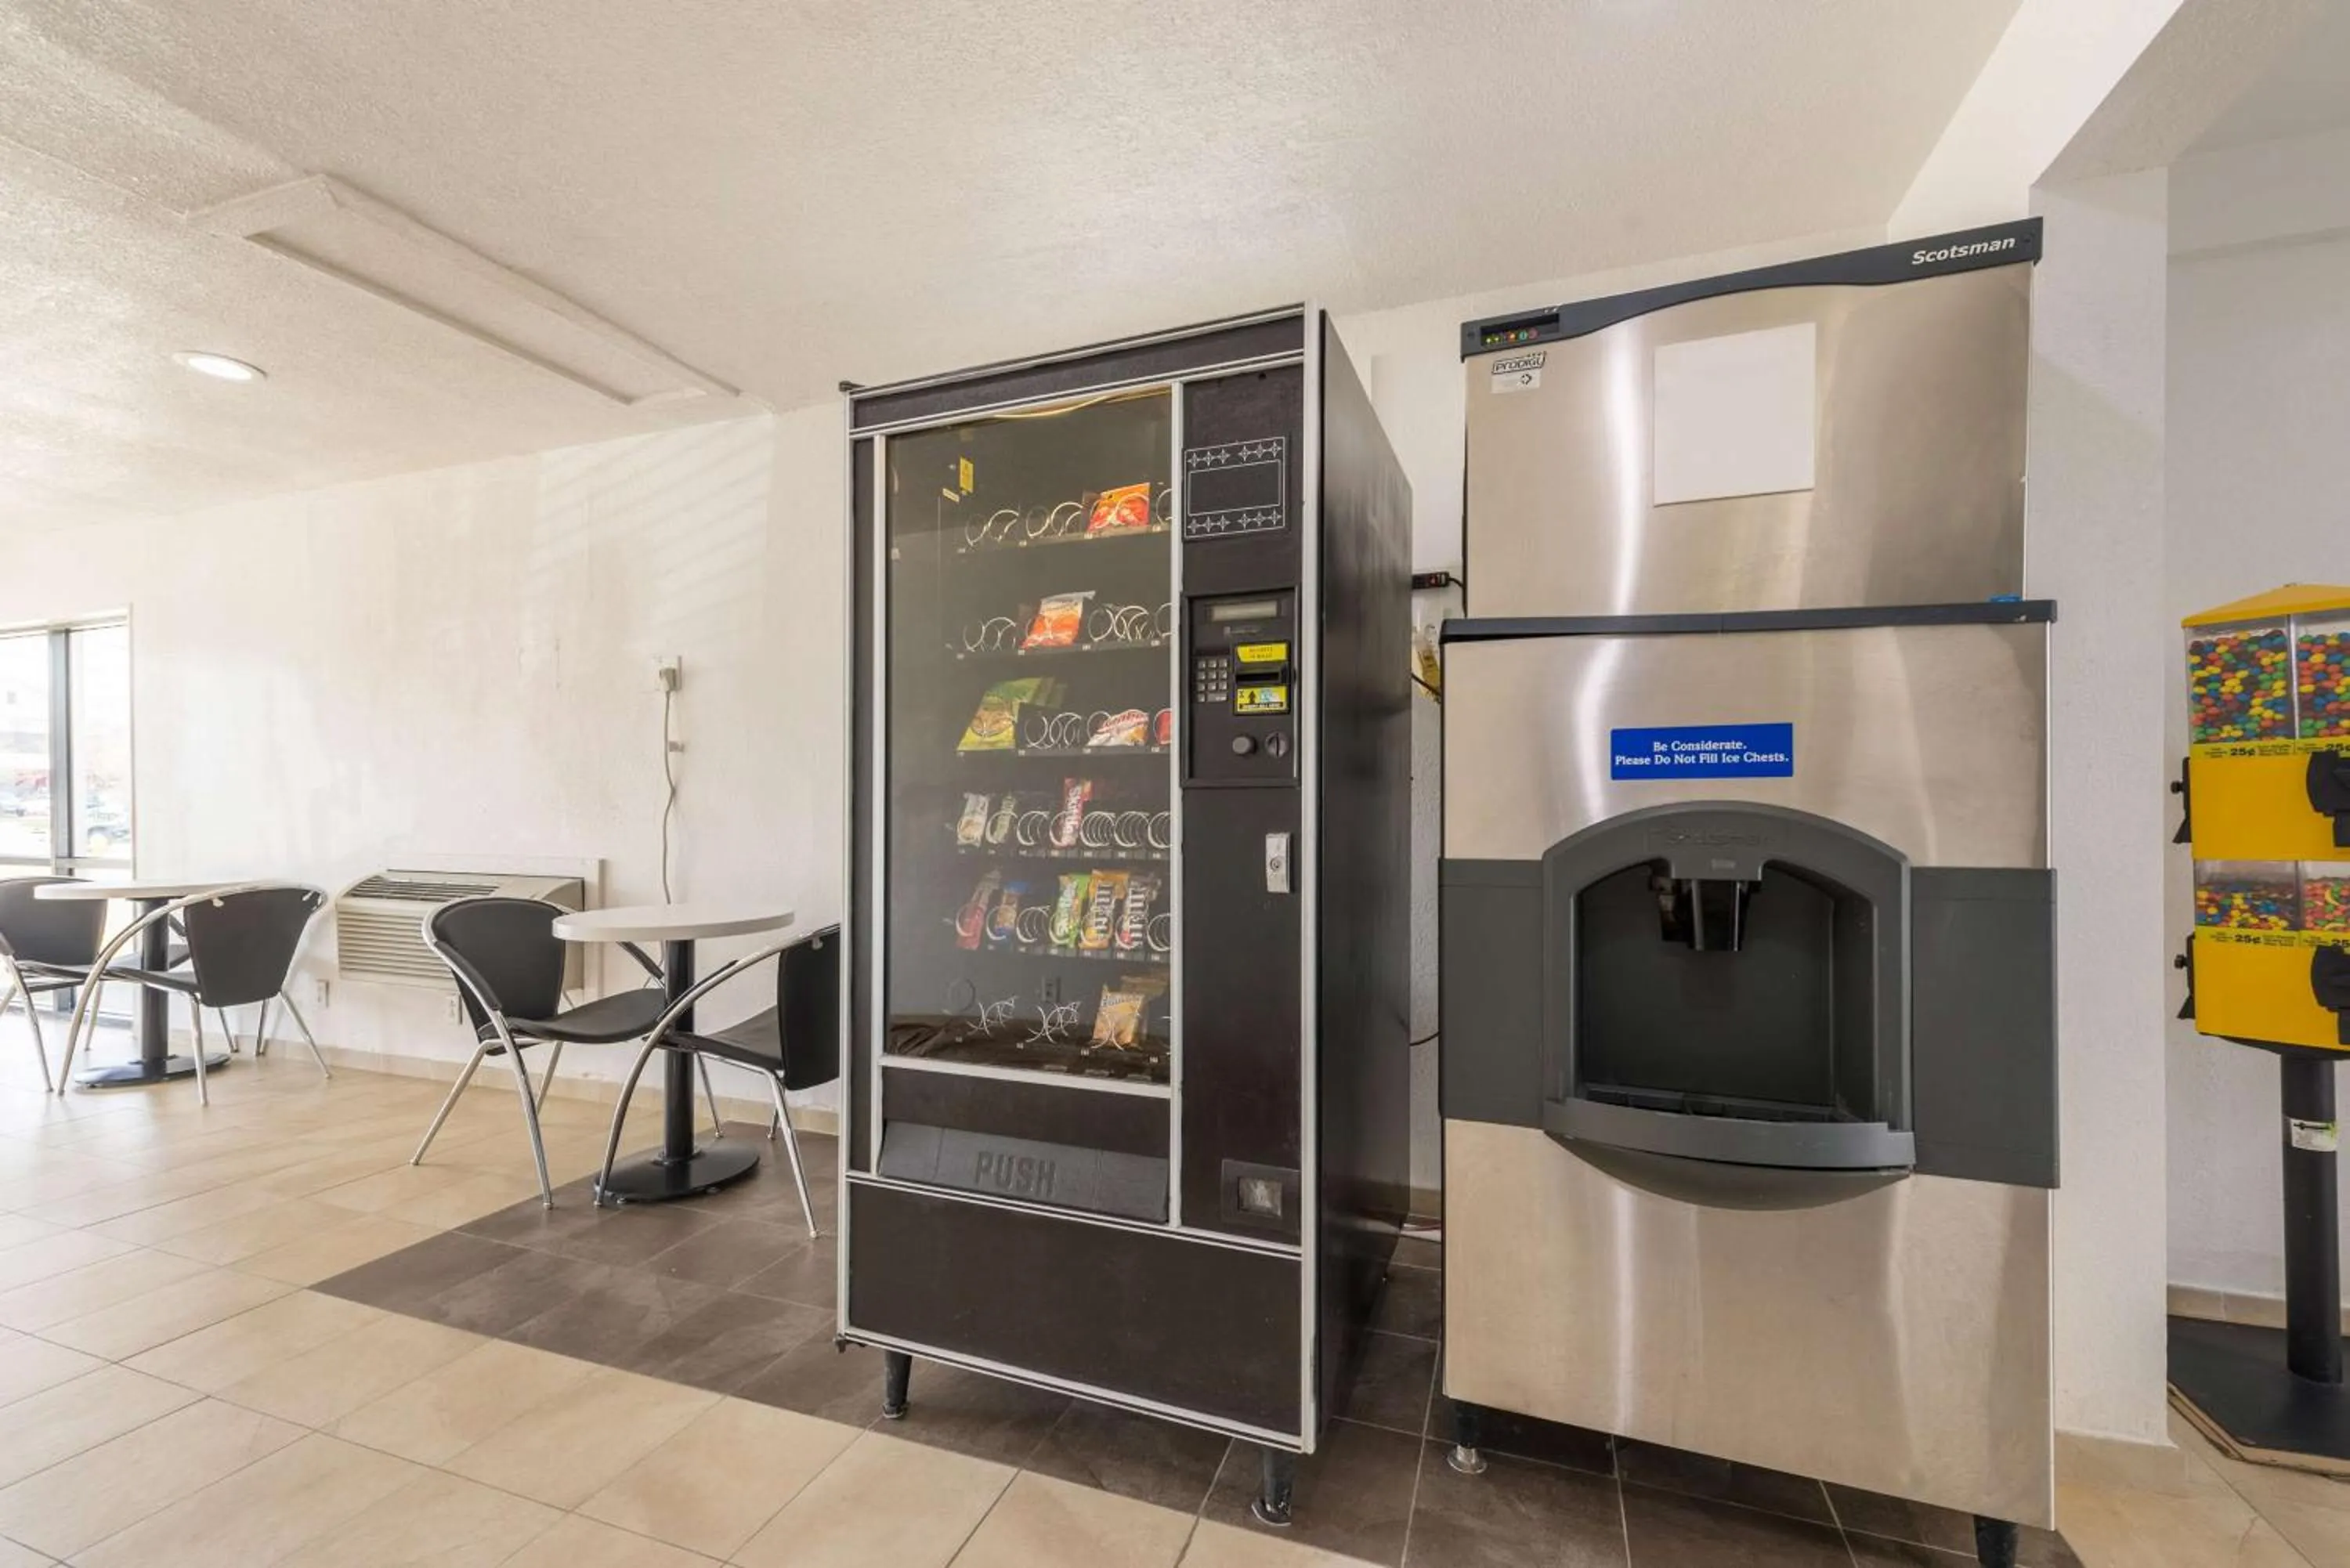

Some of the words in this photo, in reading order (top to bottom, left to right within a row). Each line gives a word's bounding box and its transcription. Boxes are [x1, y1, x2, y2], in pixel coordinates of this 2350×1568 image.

[1911, 237, 2016, 265] Scotsman
[1653, 742, 1668, 752] Be
[1671, 739, 1748, 751] Considerate.
[1614, 755, 1651, 765] Please
[1654, 755, 1671, 764] Do
[1674, 754, 1696, 764] Not
[1699, 753, 1718, 764] Fill
[1722, 753, 1740, 763] Ice
[1743, 751, 1789, 763] Chests.
[974, 1151, 1056, 1198] PUSH
